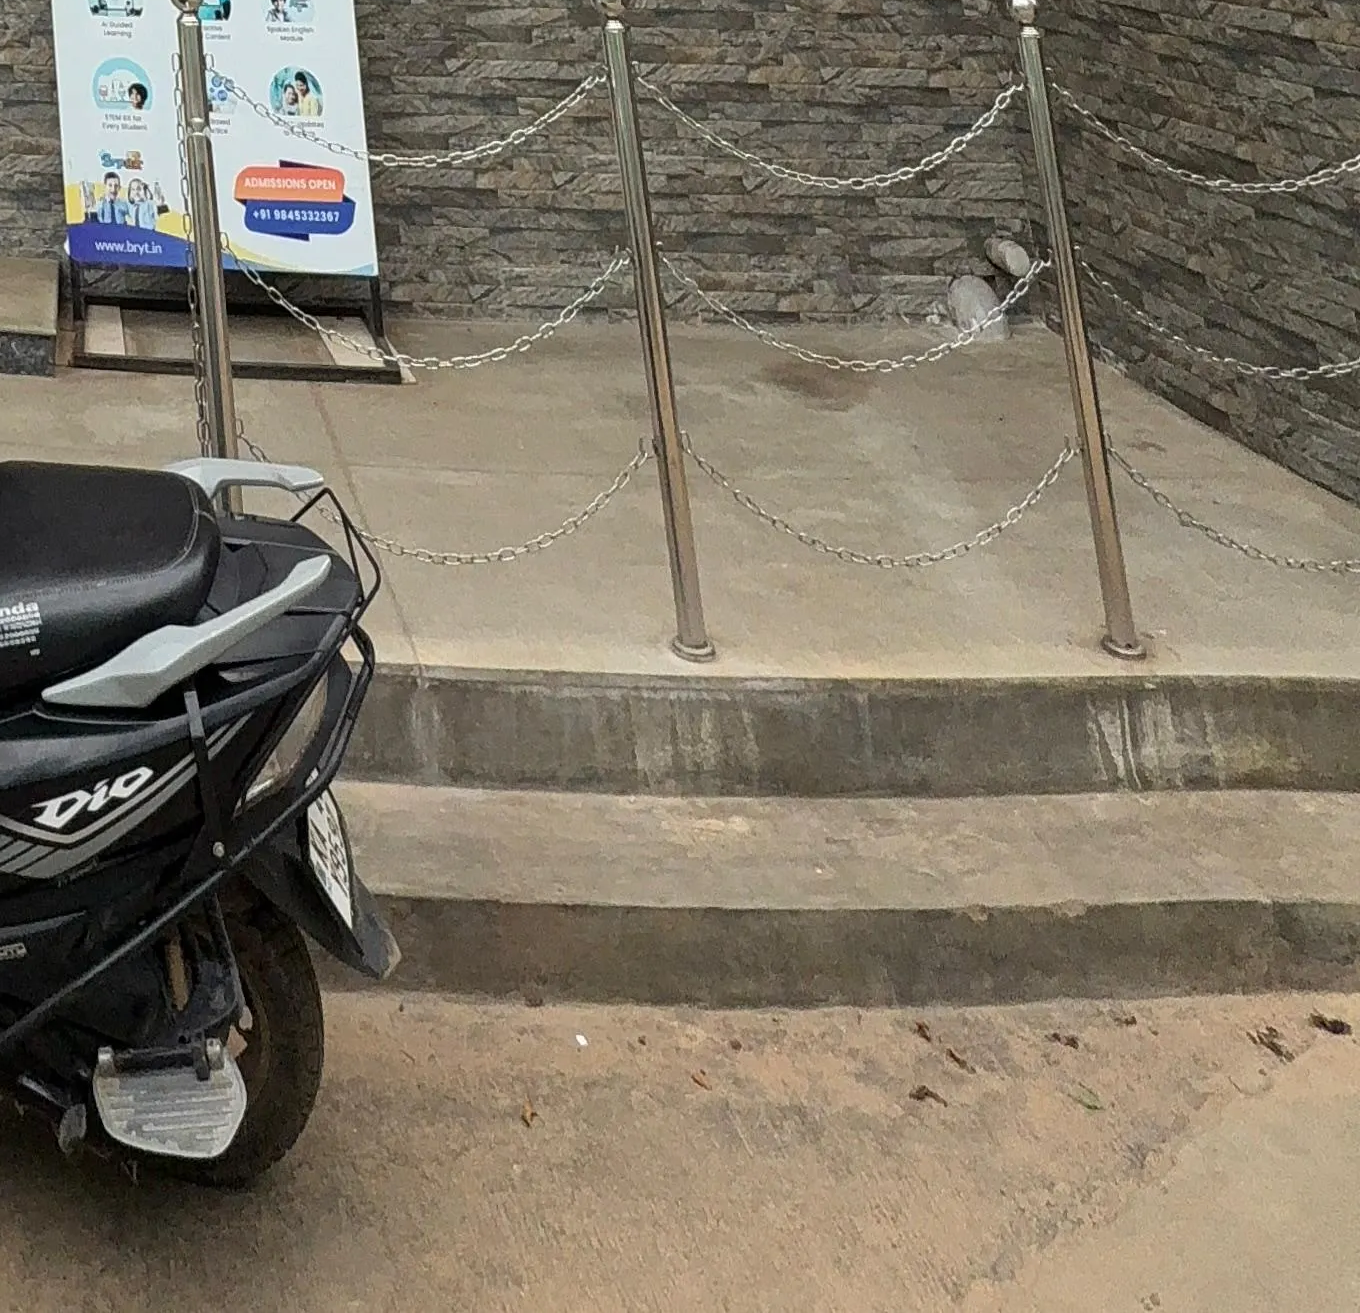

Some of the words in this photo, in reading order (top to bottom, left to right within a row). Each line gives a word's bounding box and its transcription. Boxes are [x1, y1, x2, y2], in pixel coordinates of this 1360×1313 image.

[243, 177, 307, 190] ADMISSIONS
[309, 178, 336, 191] OPEN
[252, 208, 271, 221] +91
[94, 238, 163, 255] www.bryt.in
[31, 766, 155, 829] Dio
